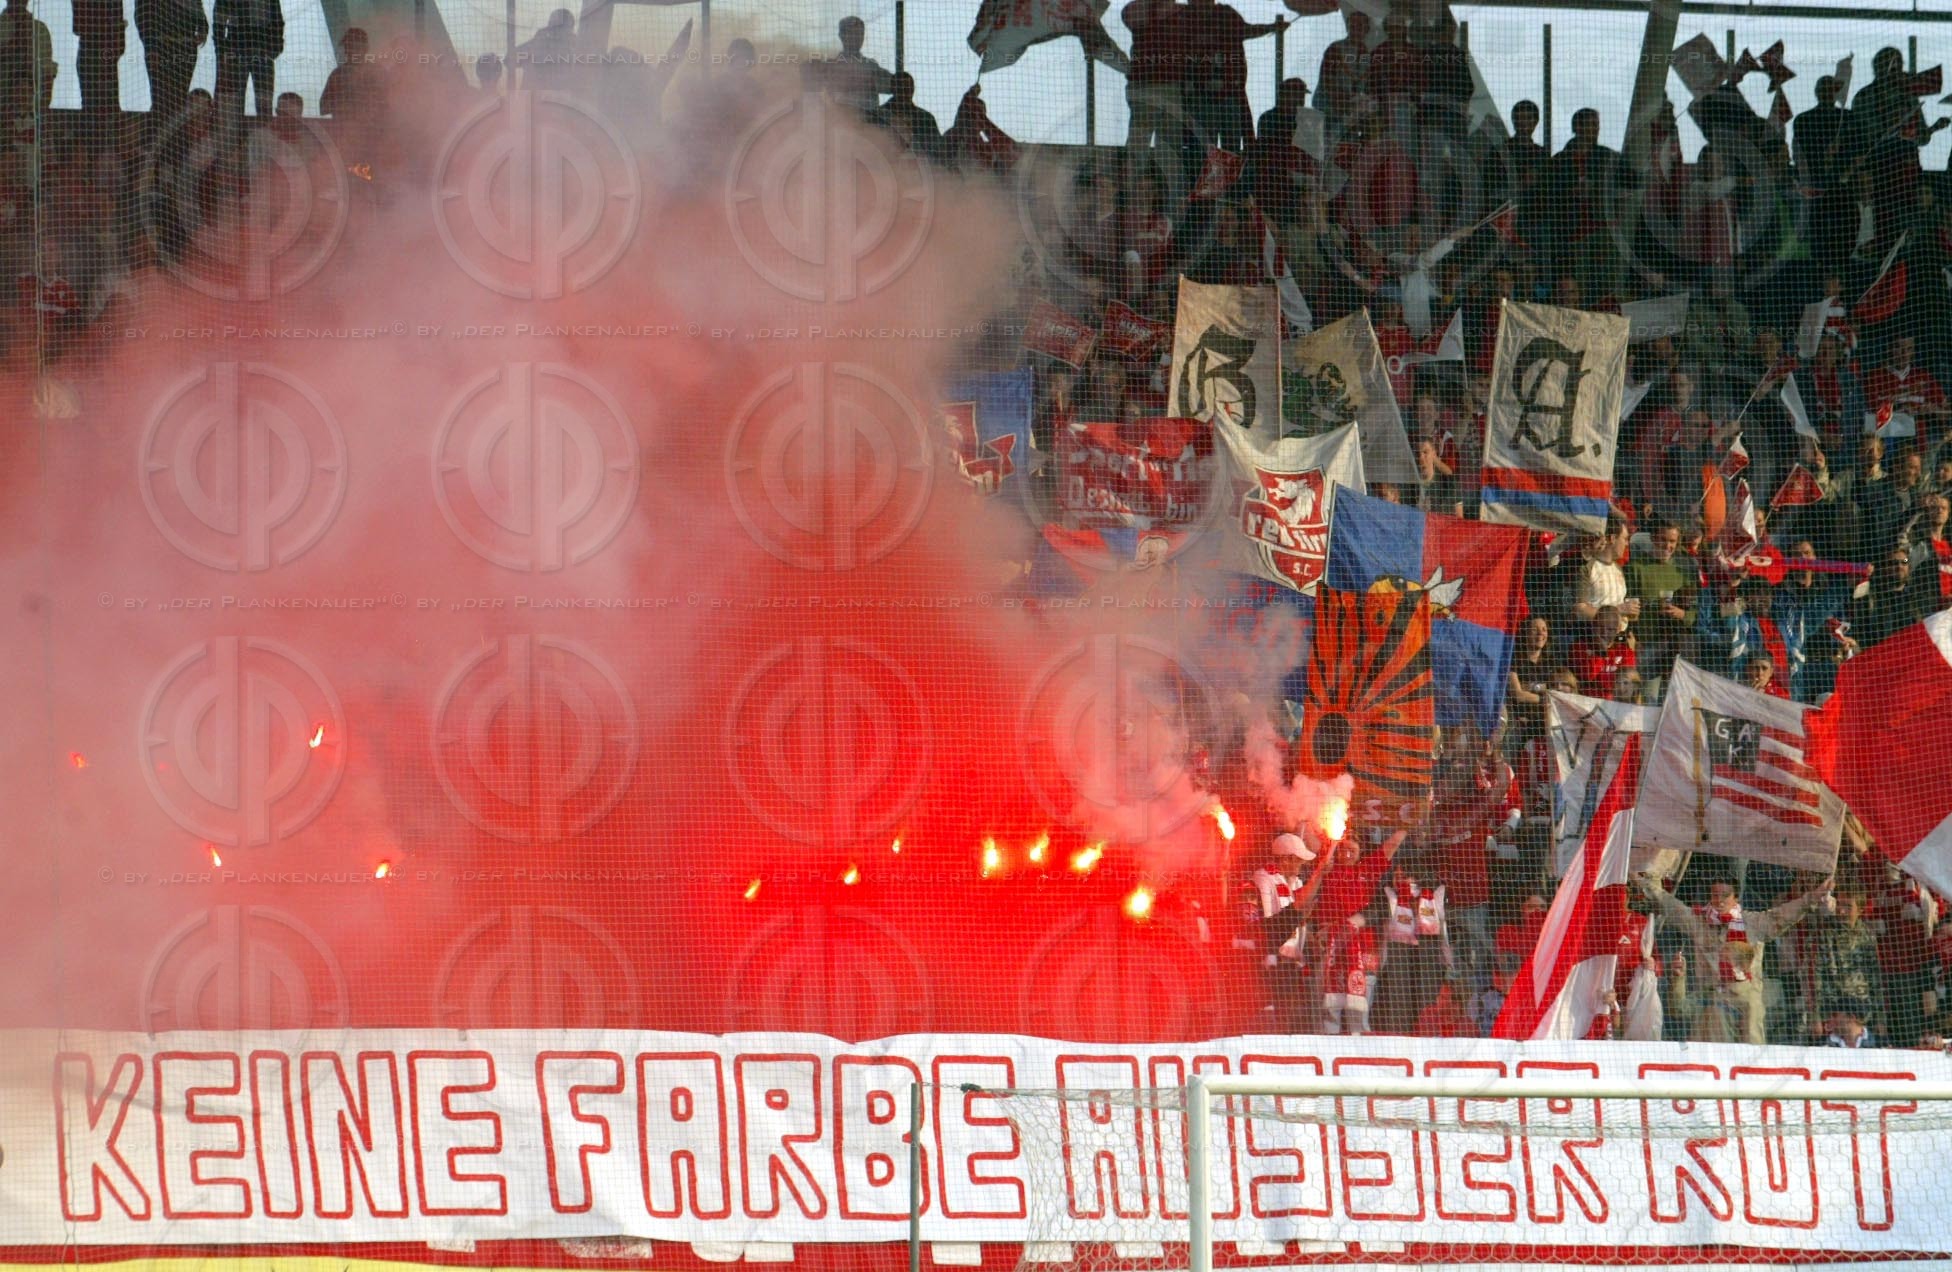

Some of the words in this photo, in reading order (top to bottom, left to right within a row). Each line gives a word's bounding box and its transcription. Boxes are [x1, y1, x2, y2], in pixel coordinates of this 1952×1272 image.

[55, 1050, 508, 1221] KEINE
[536, 1050, 1027, 1220] FARBE
[1055, 1053, 1609, 1224] AUSSER
[1638, 1063, 1918, 1231] ROT
